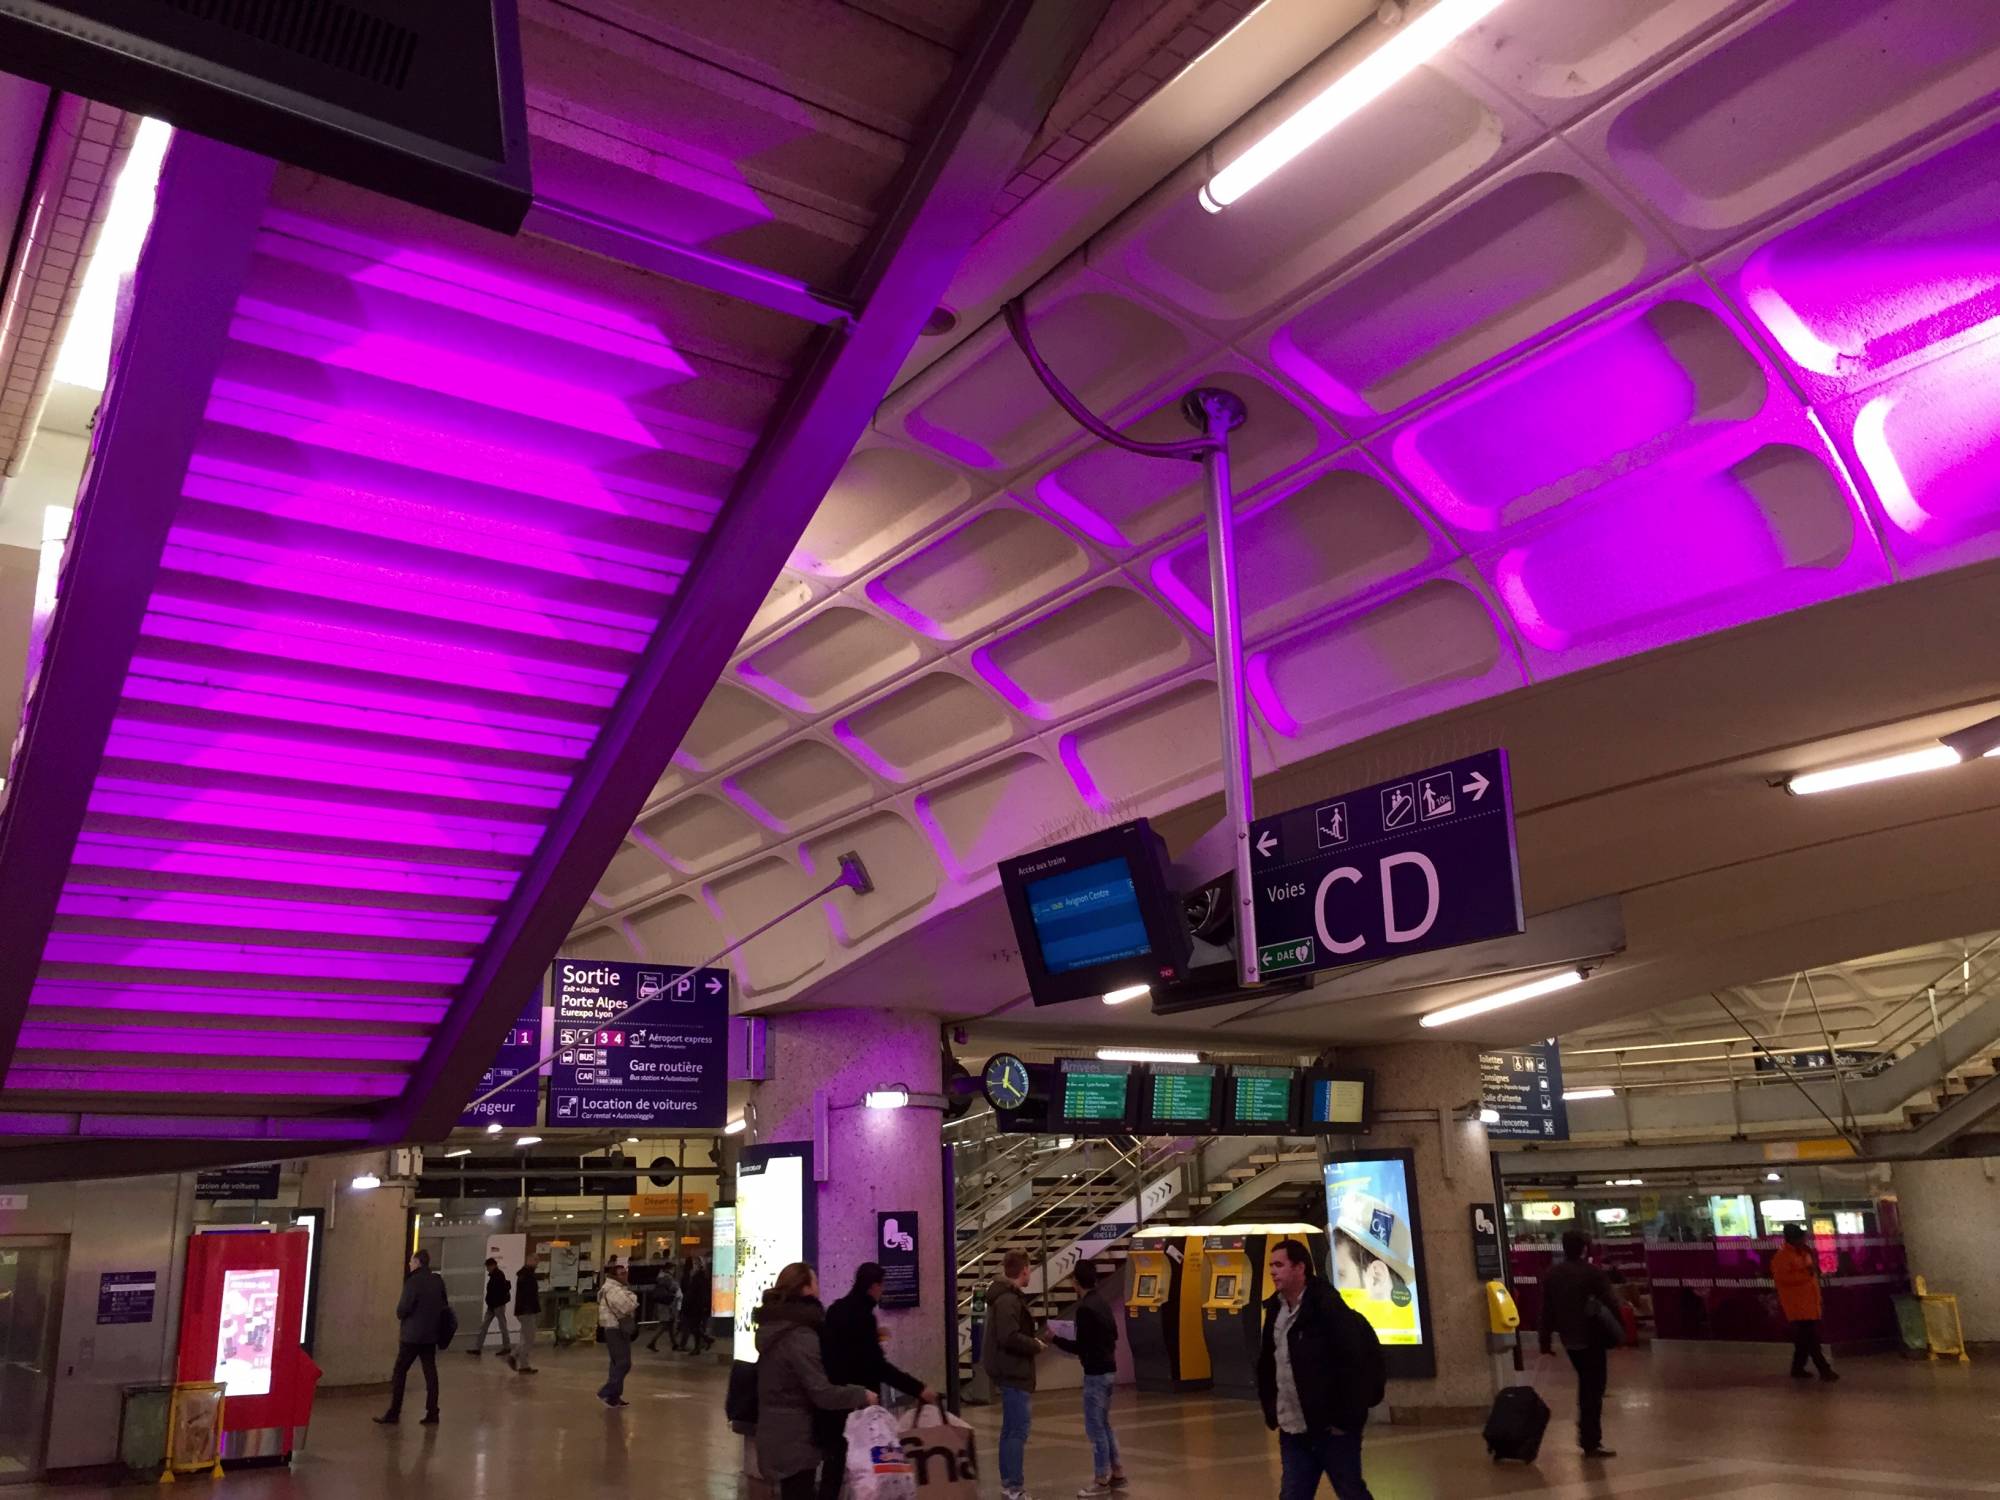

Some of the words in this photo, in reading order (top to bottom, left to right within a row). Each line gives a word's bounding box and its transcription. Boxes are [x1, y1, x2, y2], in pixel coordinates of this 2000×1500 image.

[1018, 865, 1036, 876] Accès
[1036, 862, 1048, 871] aux
[1047, 855, 1067, 868] trains
[1267, 881, 1306, 903] Voies
[1277, 949, 1295, 962] DAE
[562, 964, 621, 986] Sortie
[561, 994, 594, 1008] Porte
[595, 996, 629, 1011] Alpes
[560, 1007, 594, 1018] Eurexpo
[594, 1009, 614, 1019] Lyon
[520, 1031, 529, 1044] 1
[600, 1032, 609, 1044] 3
[614, 1033, 622, 1044] 4
[648, 1033, 683, 1044] Aéroport
[684, 1036, 713, 1044] express
[579, 1053, 594, 1061] BUS
[629, 1059, 657, 1072] Gare
[658, 1061, 703, 1073] routière
[1061, 1060, 1101, 1073] Arrivées
[1150, 1063, 1188, 1075] Arrivées
[577, 1072, 593, 1080] CAR
[629, 1073, 640, 1081] Bus
[582, 1097, 633, 1110] Location
[635, 1098, 650, 1110] de
[652, 1098, 698, 1111] voitures
